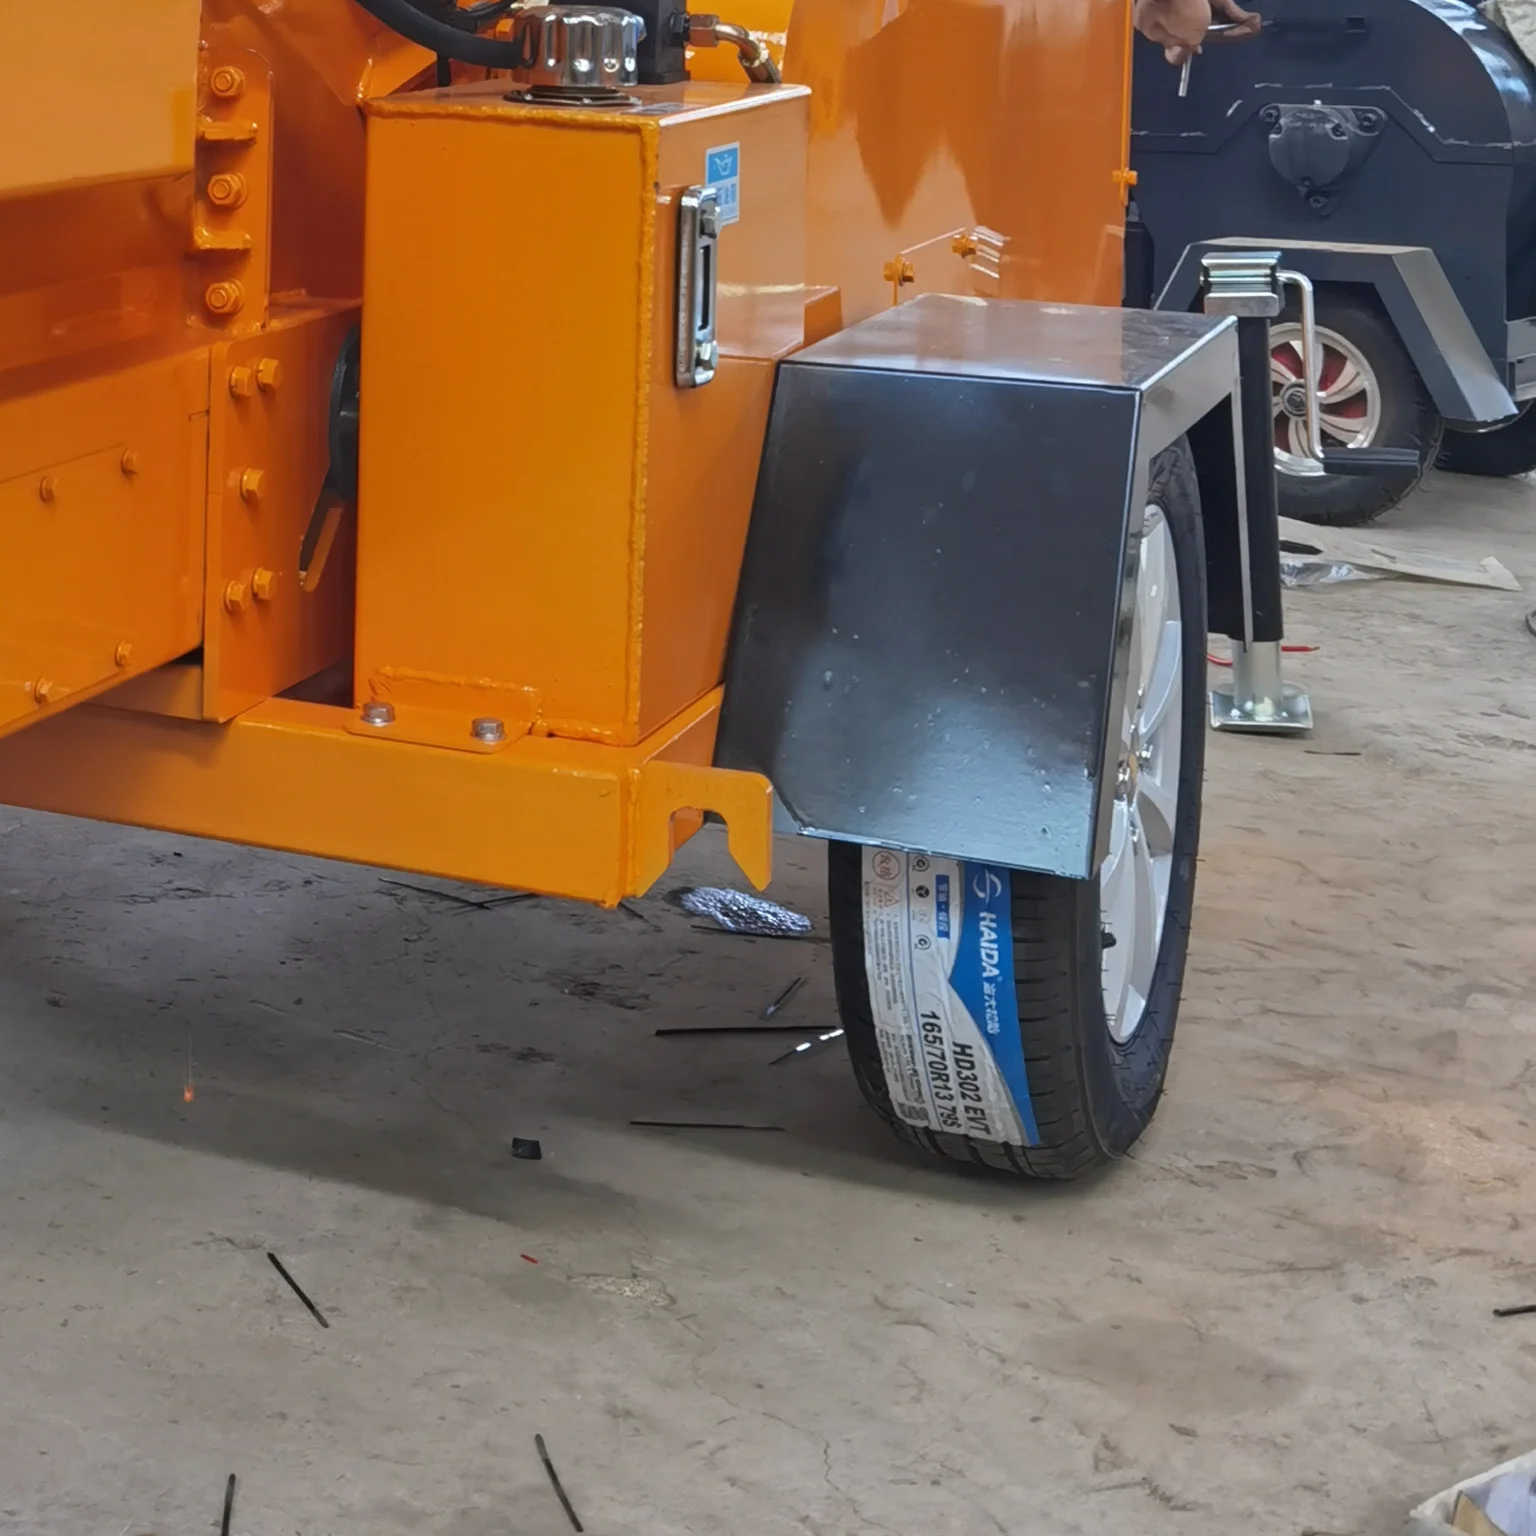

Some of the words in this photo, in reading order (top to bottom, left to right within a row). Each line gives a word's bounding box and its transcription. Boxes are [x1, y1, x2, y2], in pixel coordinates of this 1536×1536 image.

[978, 911, 1000, 978] HAIDA
[920, 1010, 955, 1102] 165/70R13
[952, 1041, 983, 1102] HD302
[963, 1105, 992, 1135] EVT
